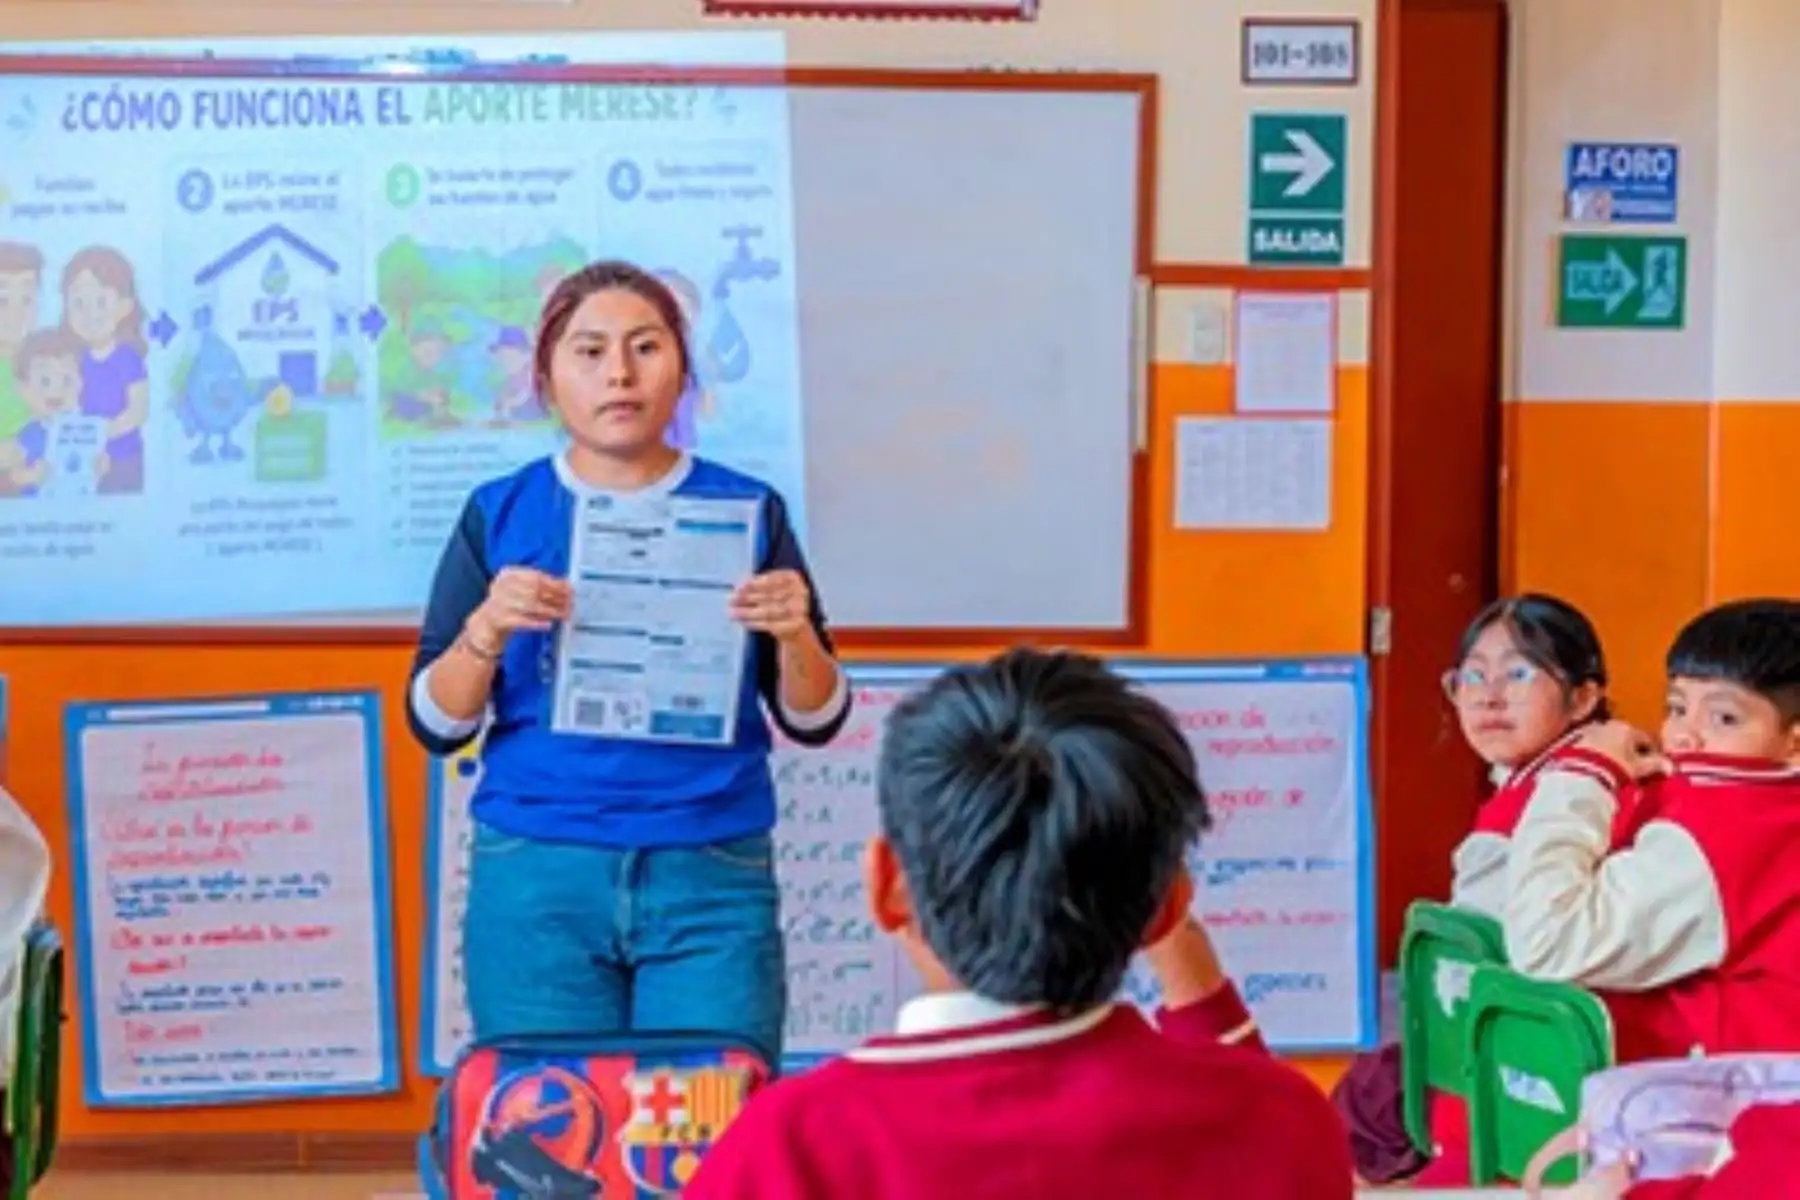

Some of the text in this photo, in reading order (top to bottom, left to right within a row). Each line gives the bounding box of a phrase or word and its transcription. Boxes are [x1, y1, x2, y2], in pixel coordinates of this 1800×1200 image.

[61, 83, 181, 131] ¿CÓMO
[193, 87, 364, 129] FUNCIONA
[376, 86, 412, 126] EL
[423, 85, 548, 124] APORTE
[1573, 147, 1673, 180] AFORO
[1253, 228, 1340, 253] SALIDA
